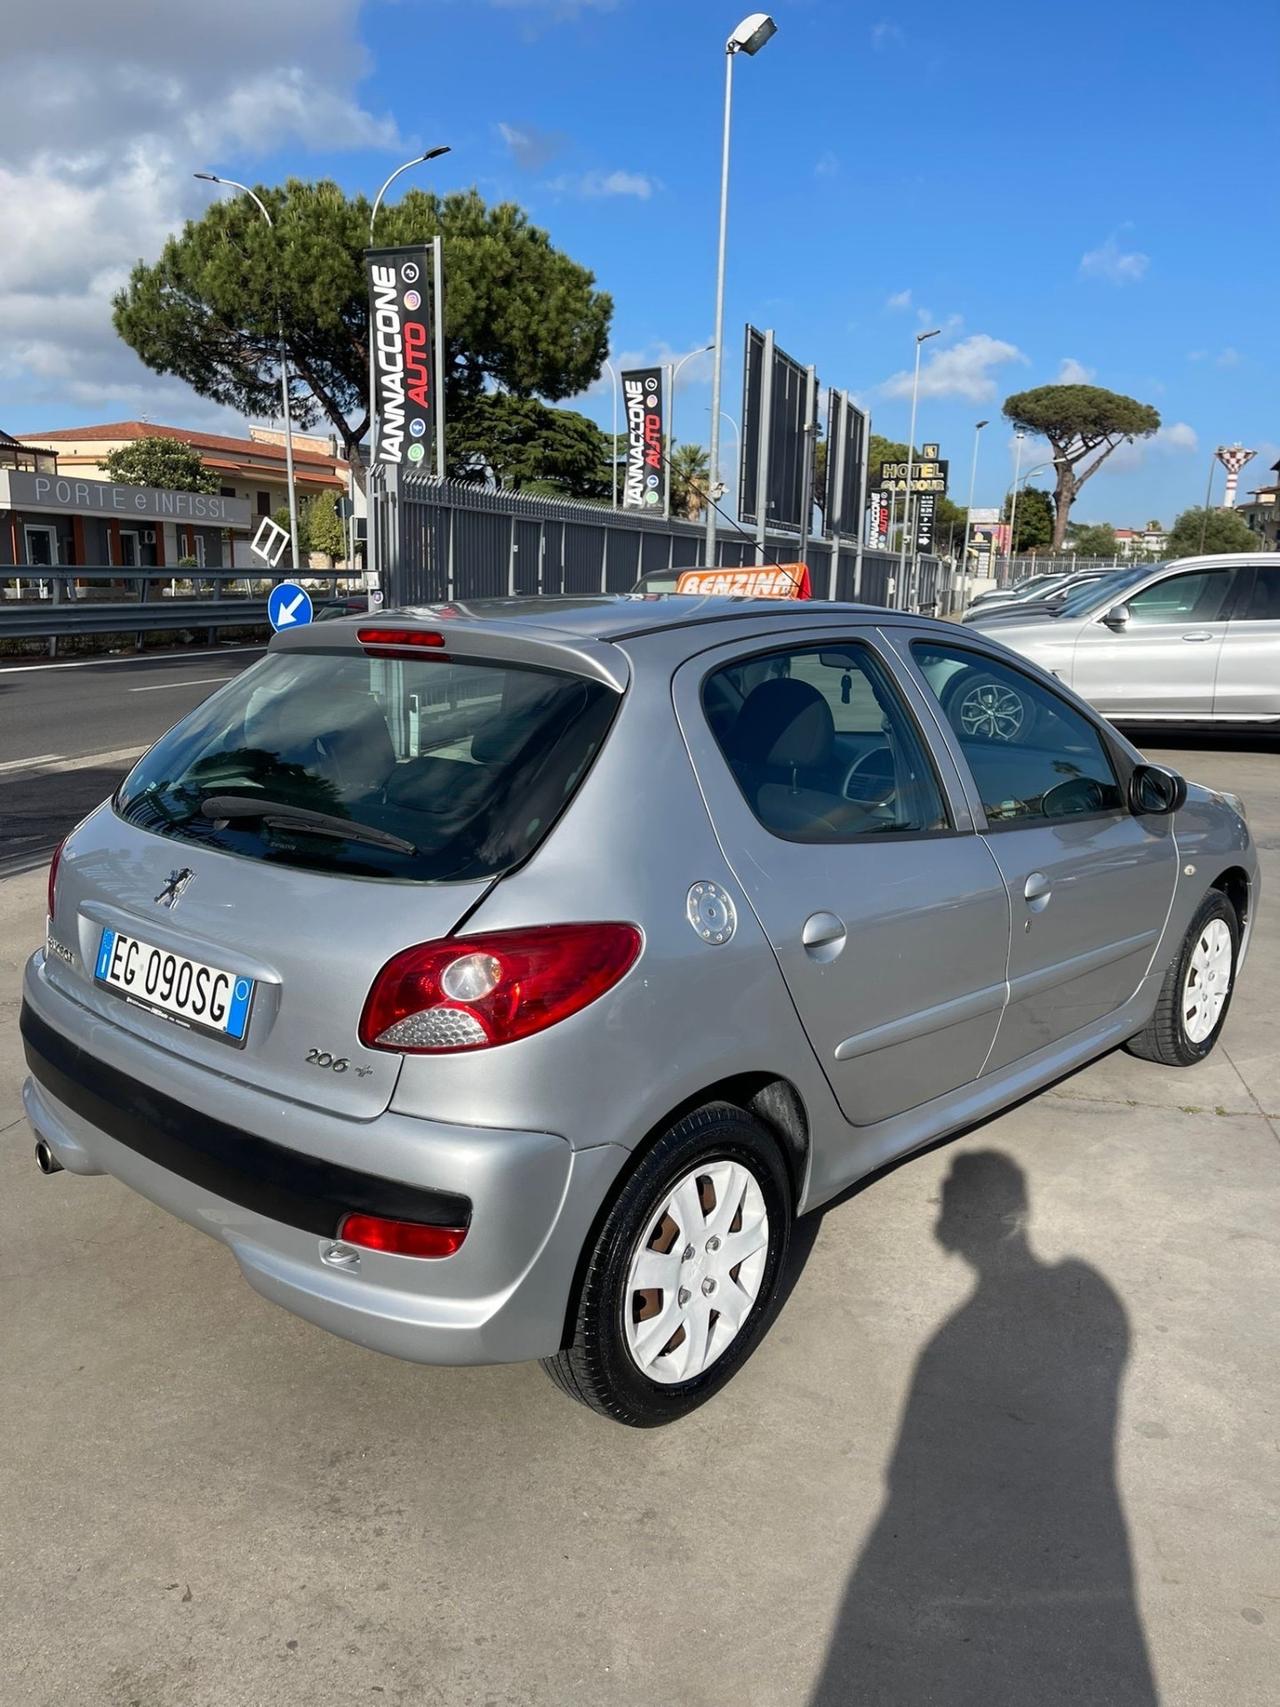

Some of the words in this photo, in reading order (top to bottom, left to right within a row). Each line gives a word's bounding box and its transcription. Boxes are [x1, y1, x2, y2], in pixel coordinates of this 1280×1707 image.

[371, 265, 405, 463] IANNACCONE
[403, 322, 429, 409] AUTO
[625, 380, 645, 506] IANNACCONE
[645, 414, 661, 469] AUTO
[882, 463, 944, 478] HOTEL
[34, 477, 126, 509] PORTE
[135, 493, 147, 509] e
[155, 492, 226, 519] INFISSI
[880, 508, 889, 534] AUTO
[681, 573, 793, 595] BENZINA
[110, 935, 139, 985] EG
[145, 949, 229, 1022] 090SG
[305, 1047, 351, 1073] 206
